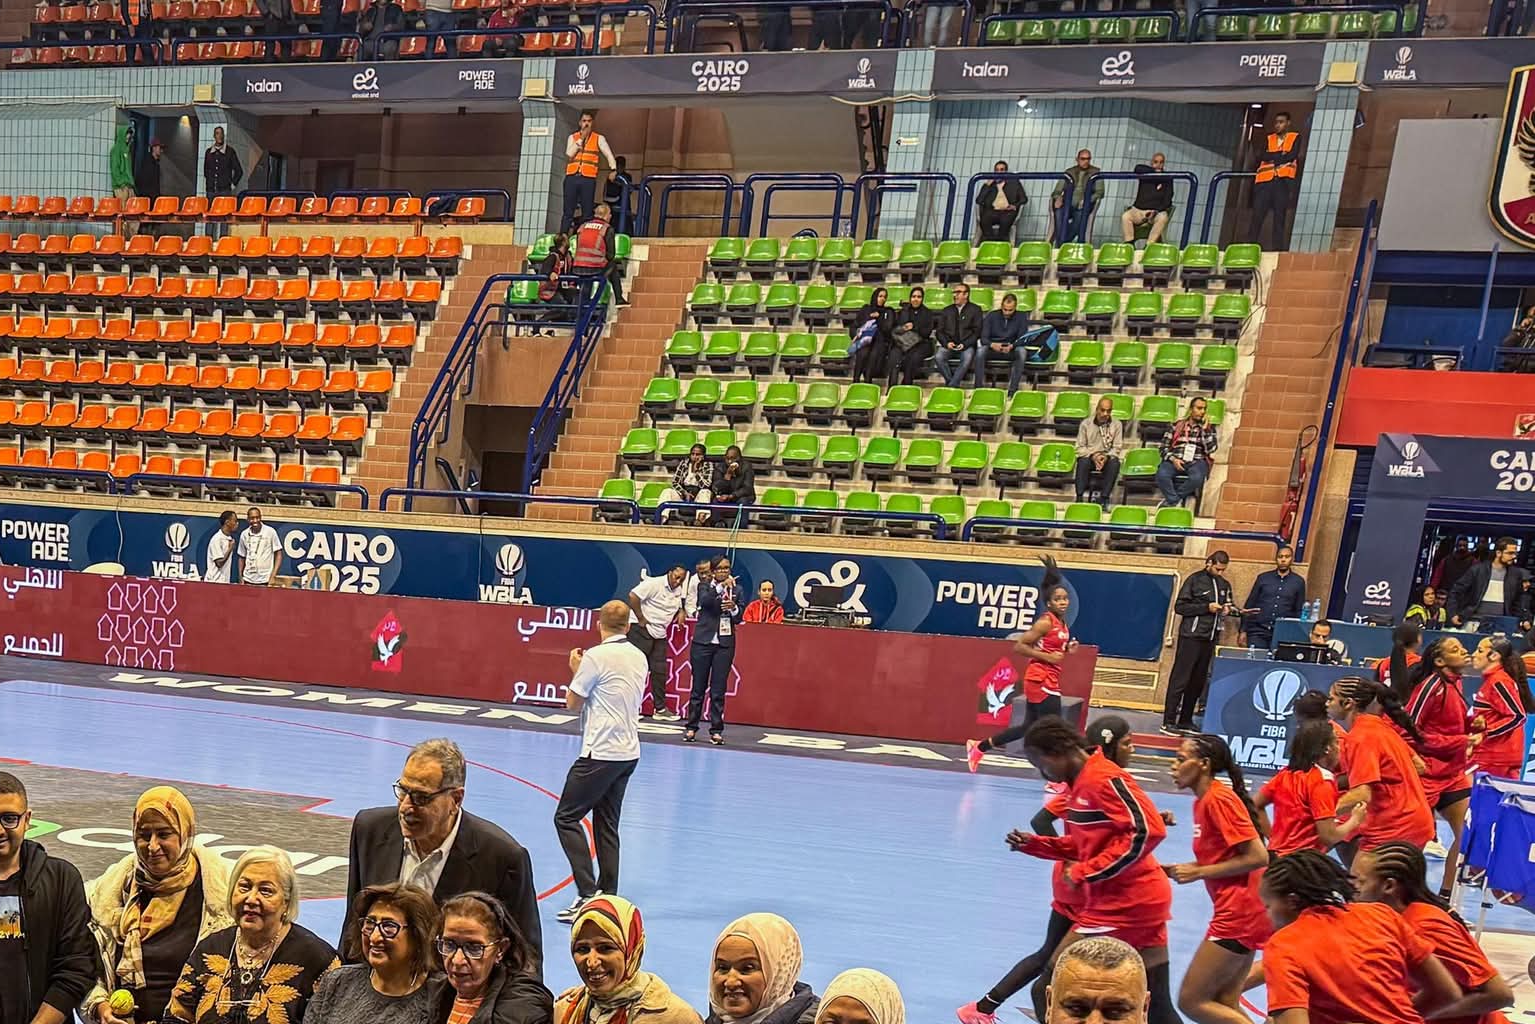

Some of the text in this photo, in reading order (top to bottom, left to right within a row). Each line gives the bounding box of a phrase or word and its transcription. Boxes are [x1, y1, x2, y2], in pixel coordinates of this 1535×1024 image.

[691, 60, 749, 77] CAIRO
[1240, 55, 1287, 68] POWER
[459, 70, 495, 82] POWER
[963, 62, 1008, 78] halan
[246, 78, 282, 93] halan
[696, 76, 741, 92] 2025
[1490, 450, 1535, 473] CAI
[1, 520, 70, 543] POWER
[283, 530, 395, 564] CAIRO
[936, 580, 1039, 609] POWER
[1260, 725, 1287, 738] FIBA
[1217, 734, 1290, 767] WBL
